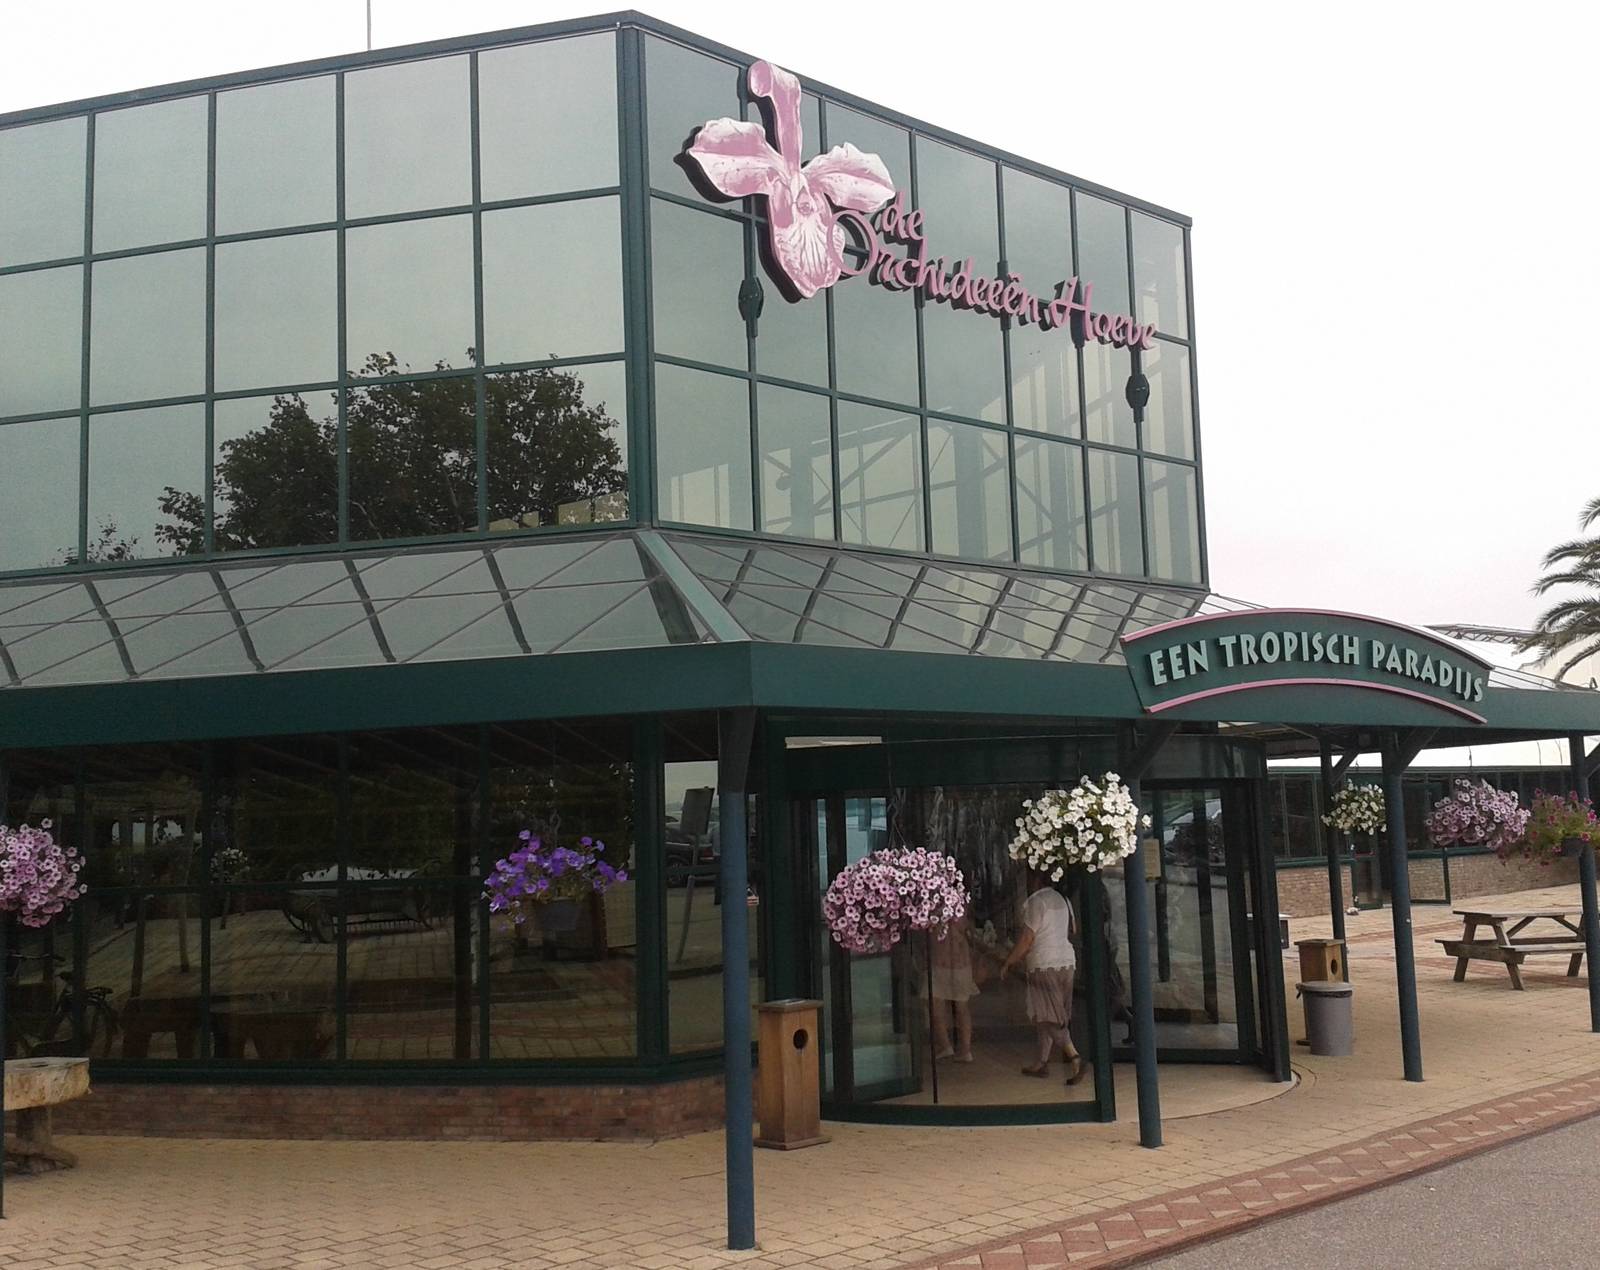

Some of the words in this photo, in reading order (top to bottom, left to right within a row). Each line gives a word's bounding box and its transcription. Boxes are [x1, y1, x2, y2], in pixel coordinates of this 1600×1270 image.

[881, 192, 926, 240] de
[1049, 275, 1156, 350] Hoeve
[1149, 639, 1209, 686] EEN
[1218, 630, 1361, 668] TROPISCH
[1371, 639, 1484, 703] PARADIJS
